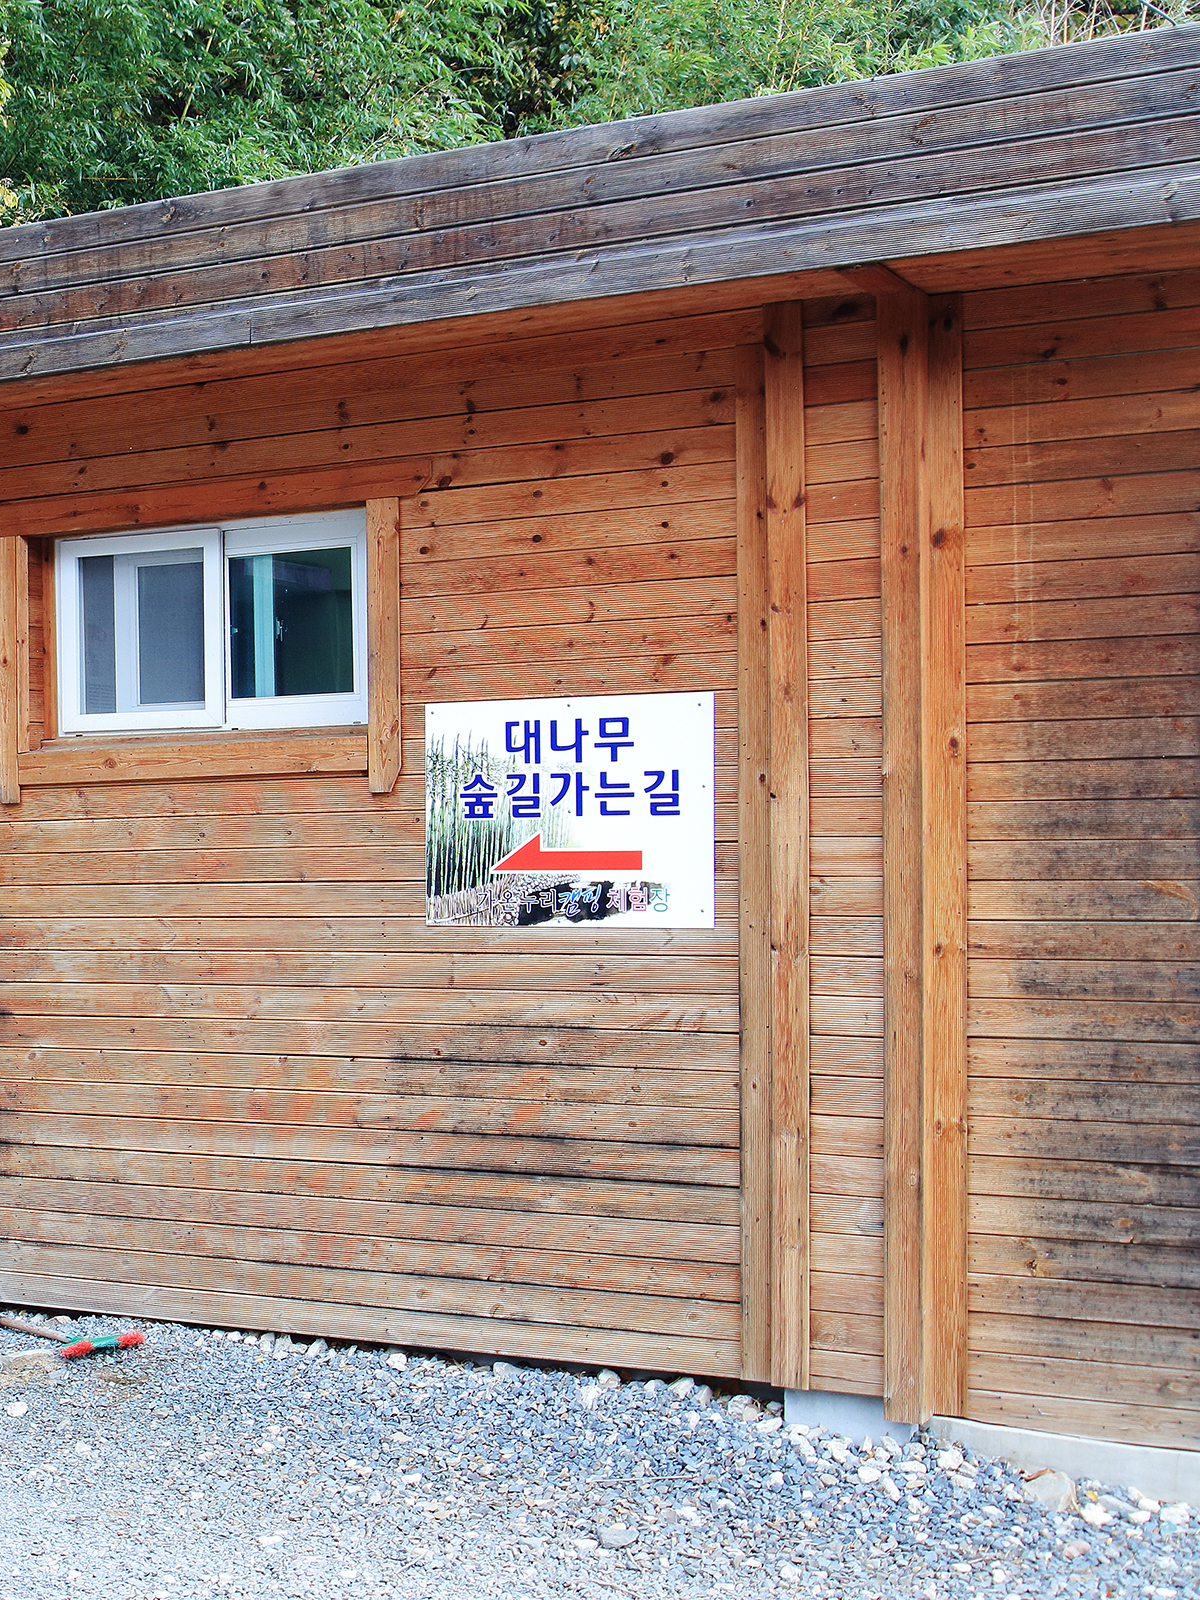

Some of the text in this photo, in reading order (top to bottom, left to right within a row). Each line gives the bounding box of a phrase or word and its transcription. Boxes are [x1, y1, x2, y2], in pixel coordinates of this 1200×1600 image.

[505, 717, 634, 764] 대나무
[460, 769, 680, 818] 숲길가는길
[607, 886, 669, 912] 체험장
